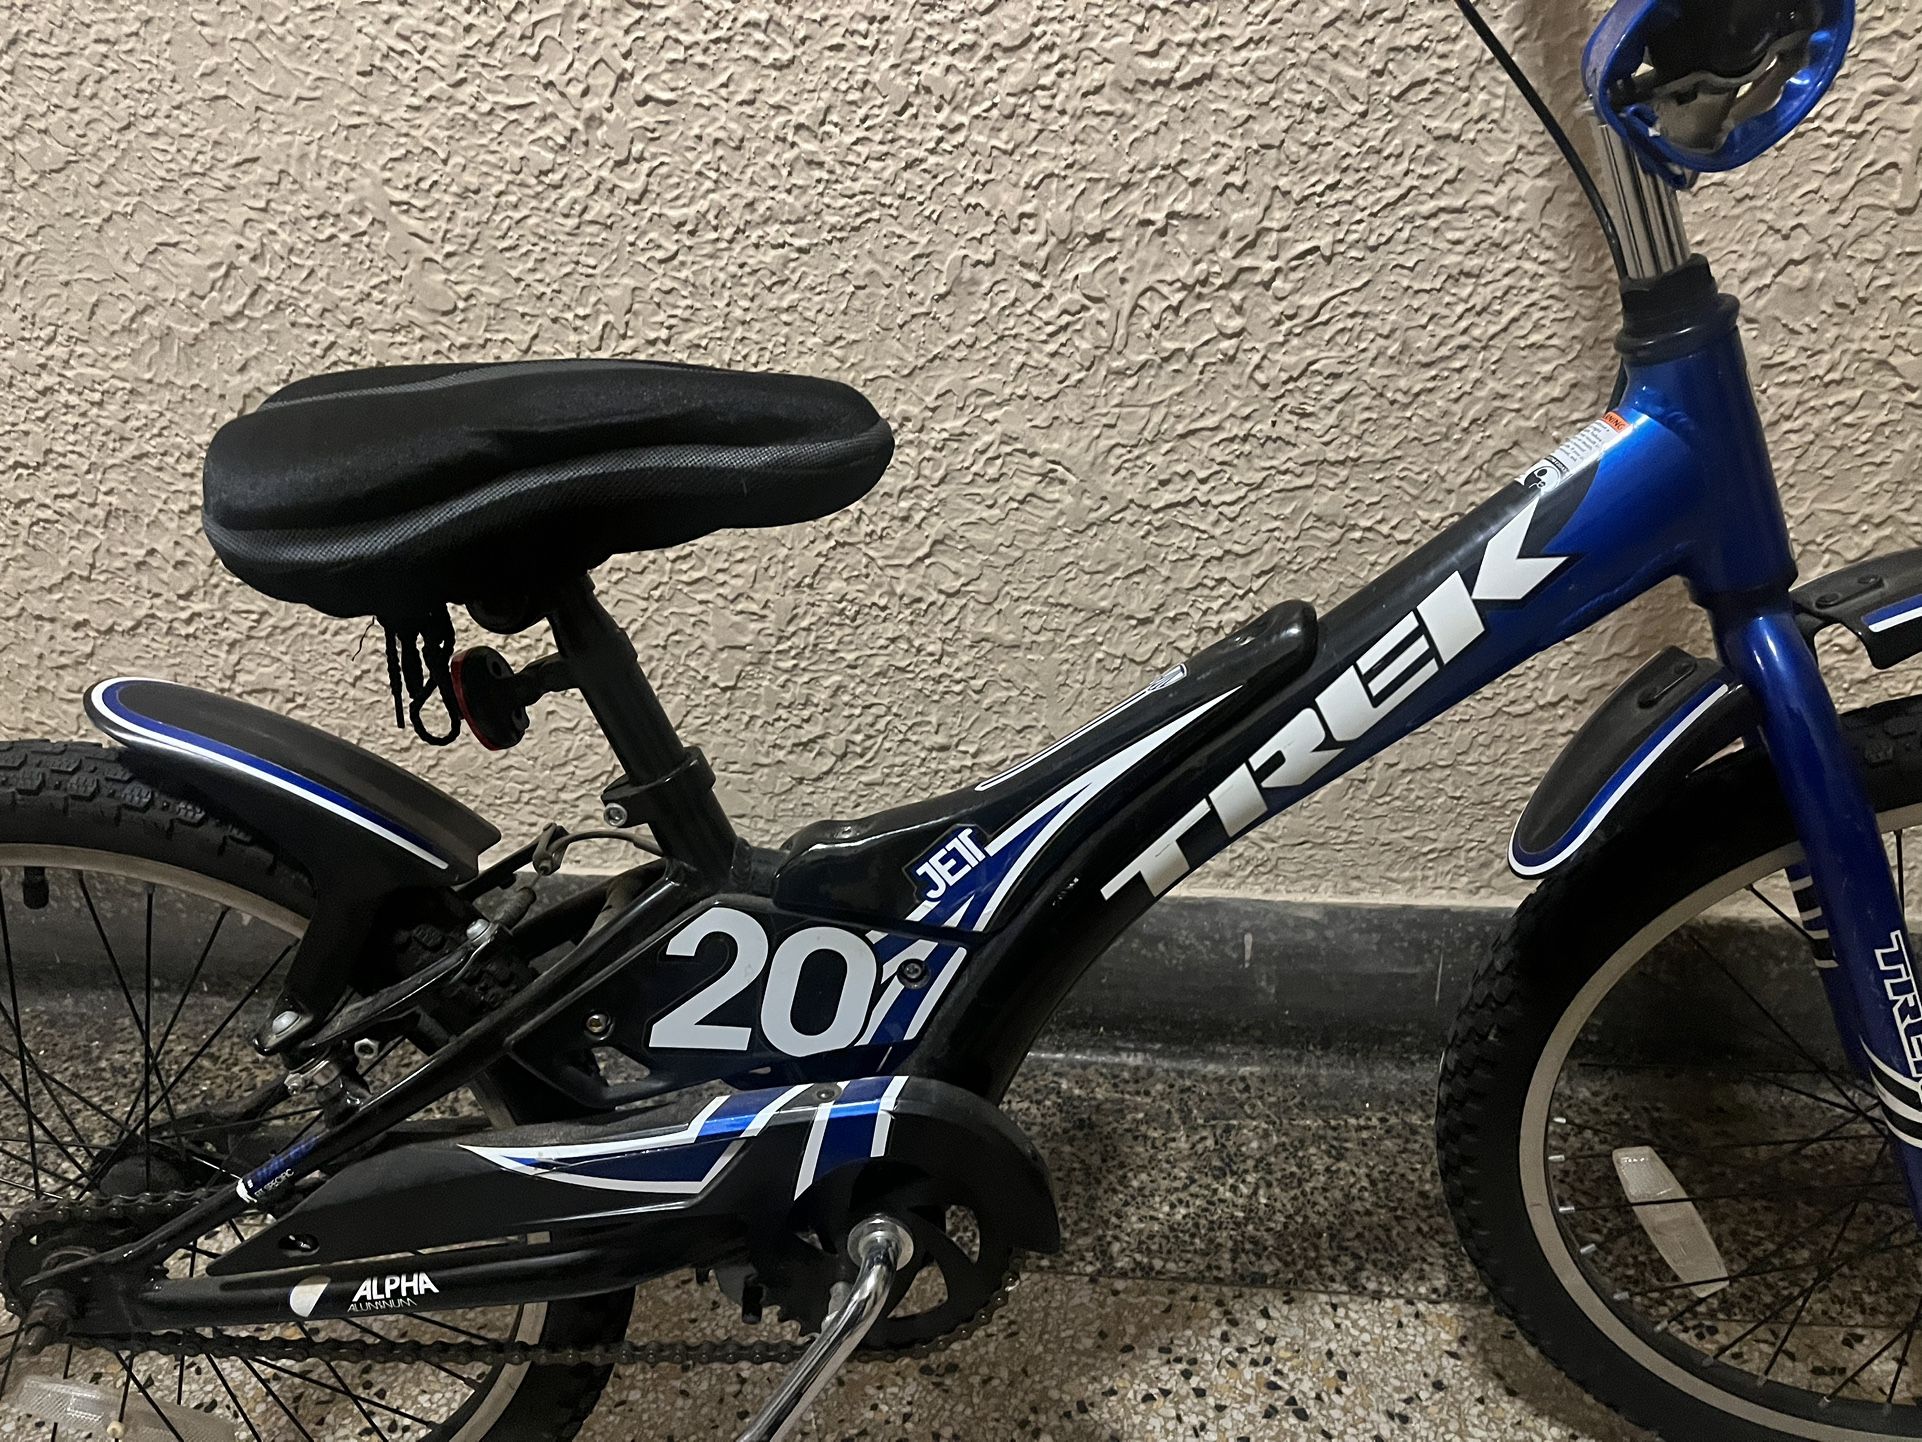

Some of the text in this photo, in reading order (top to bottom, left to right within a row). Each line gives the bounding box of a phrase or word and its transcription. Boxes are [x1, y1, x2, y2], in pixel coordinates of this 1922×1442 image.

[1101, 496, 1569, 901] TREK
[648, 907, 878, 1058] 20
[1874, 929, 1922, 1100] TRE
[346, 1297, 418, 1313] ALUMINUM
[352, 1271, 440, 1302] ALPHA
